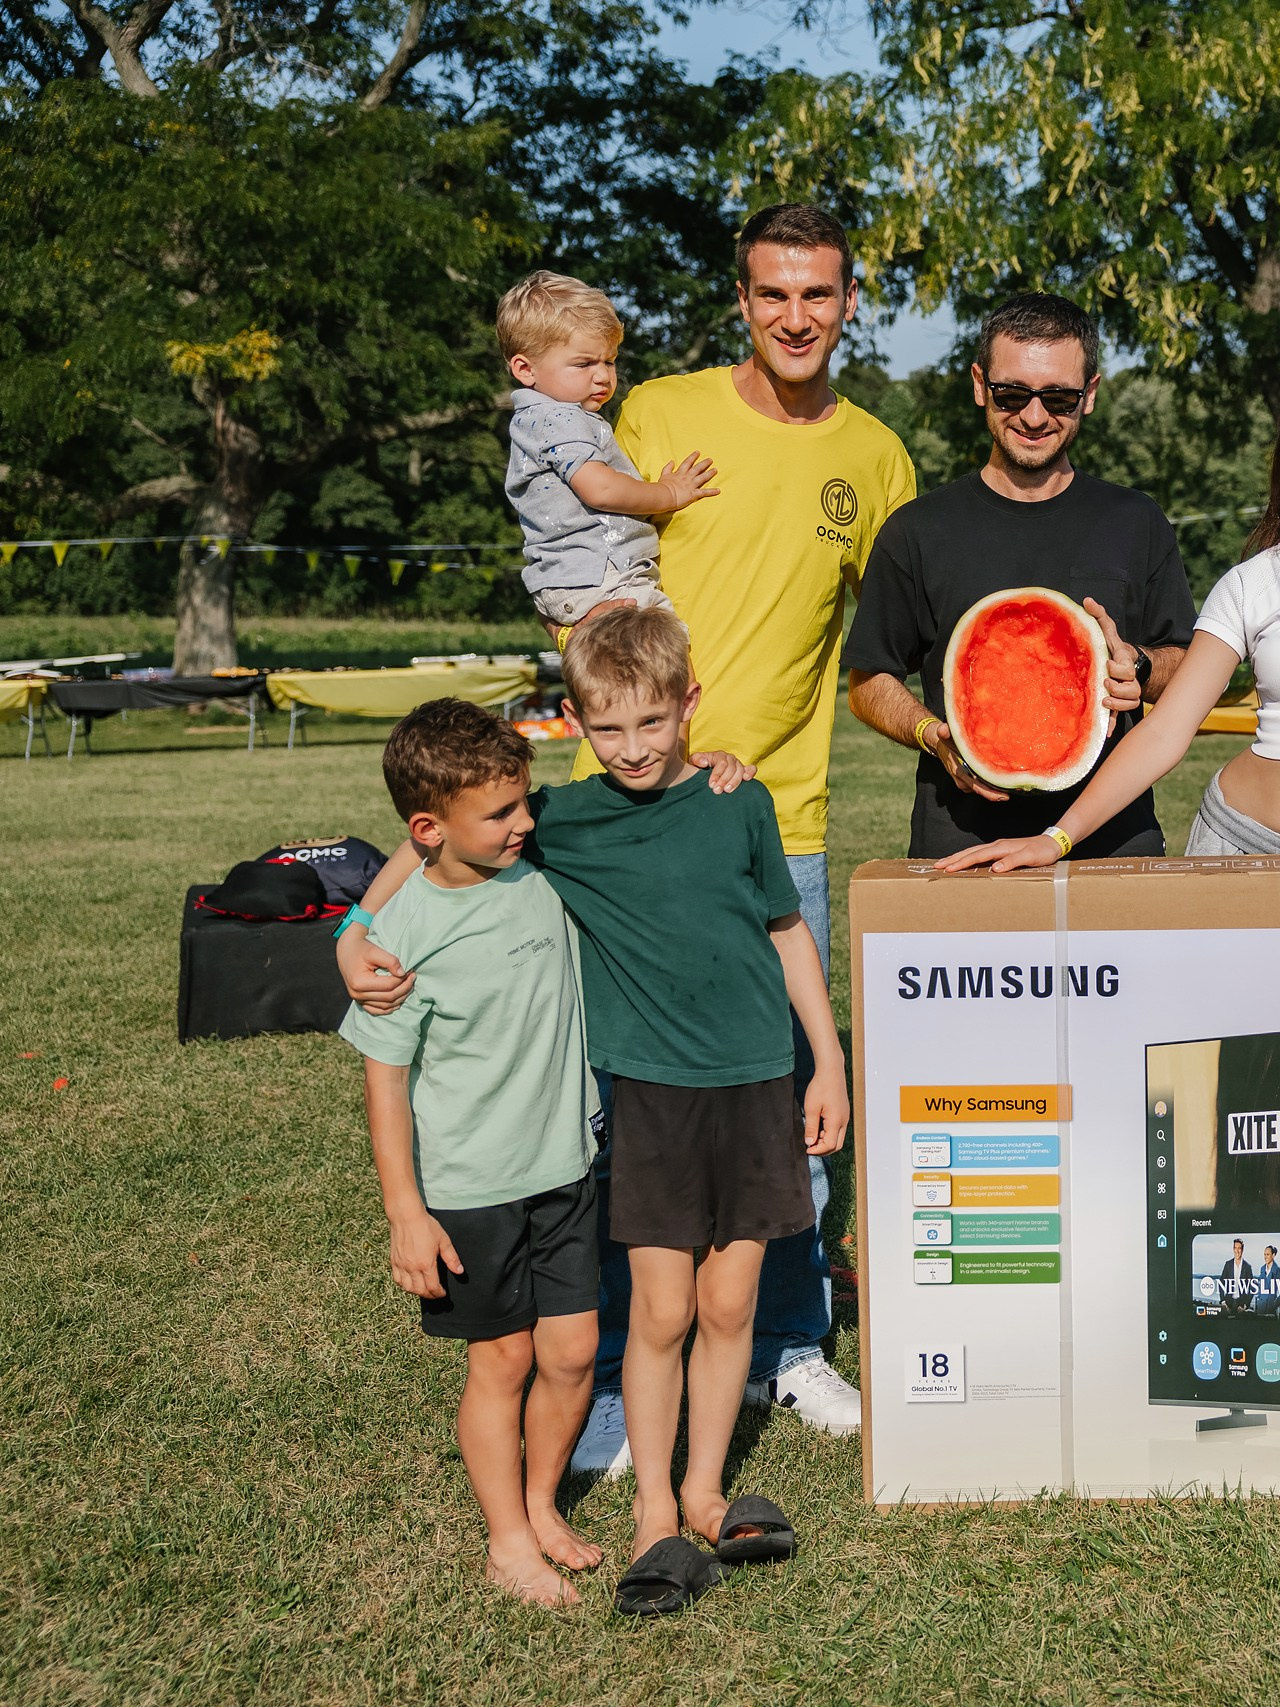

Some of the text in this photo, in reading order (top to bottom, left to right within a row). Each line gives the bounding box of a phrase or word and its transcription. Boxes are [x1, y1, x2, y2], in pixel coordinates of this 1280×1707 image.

[817, 526, 853, 549] OCMC
[898, 965, 1119, 999] SAMSUNG
[925, 1098, 1047, 1115] Why Samsung
[1232, 1114, 1278, 1151] XITE
[919, 1353, 949, 1378] 18
